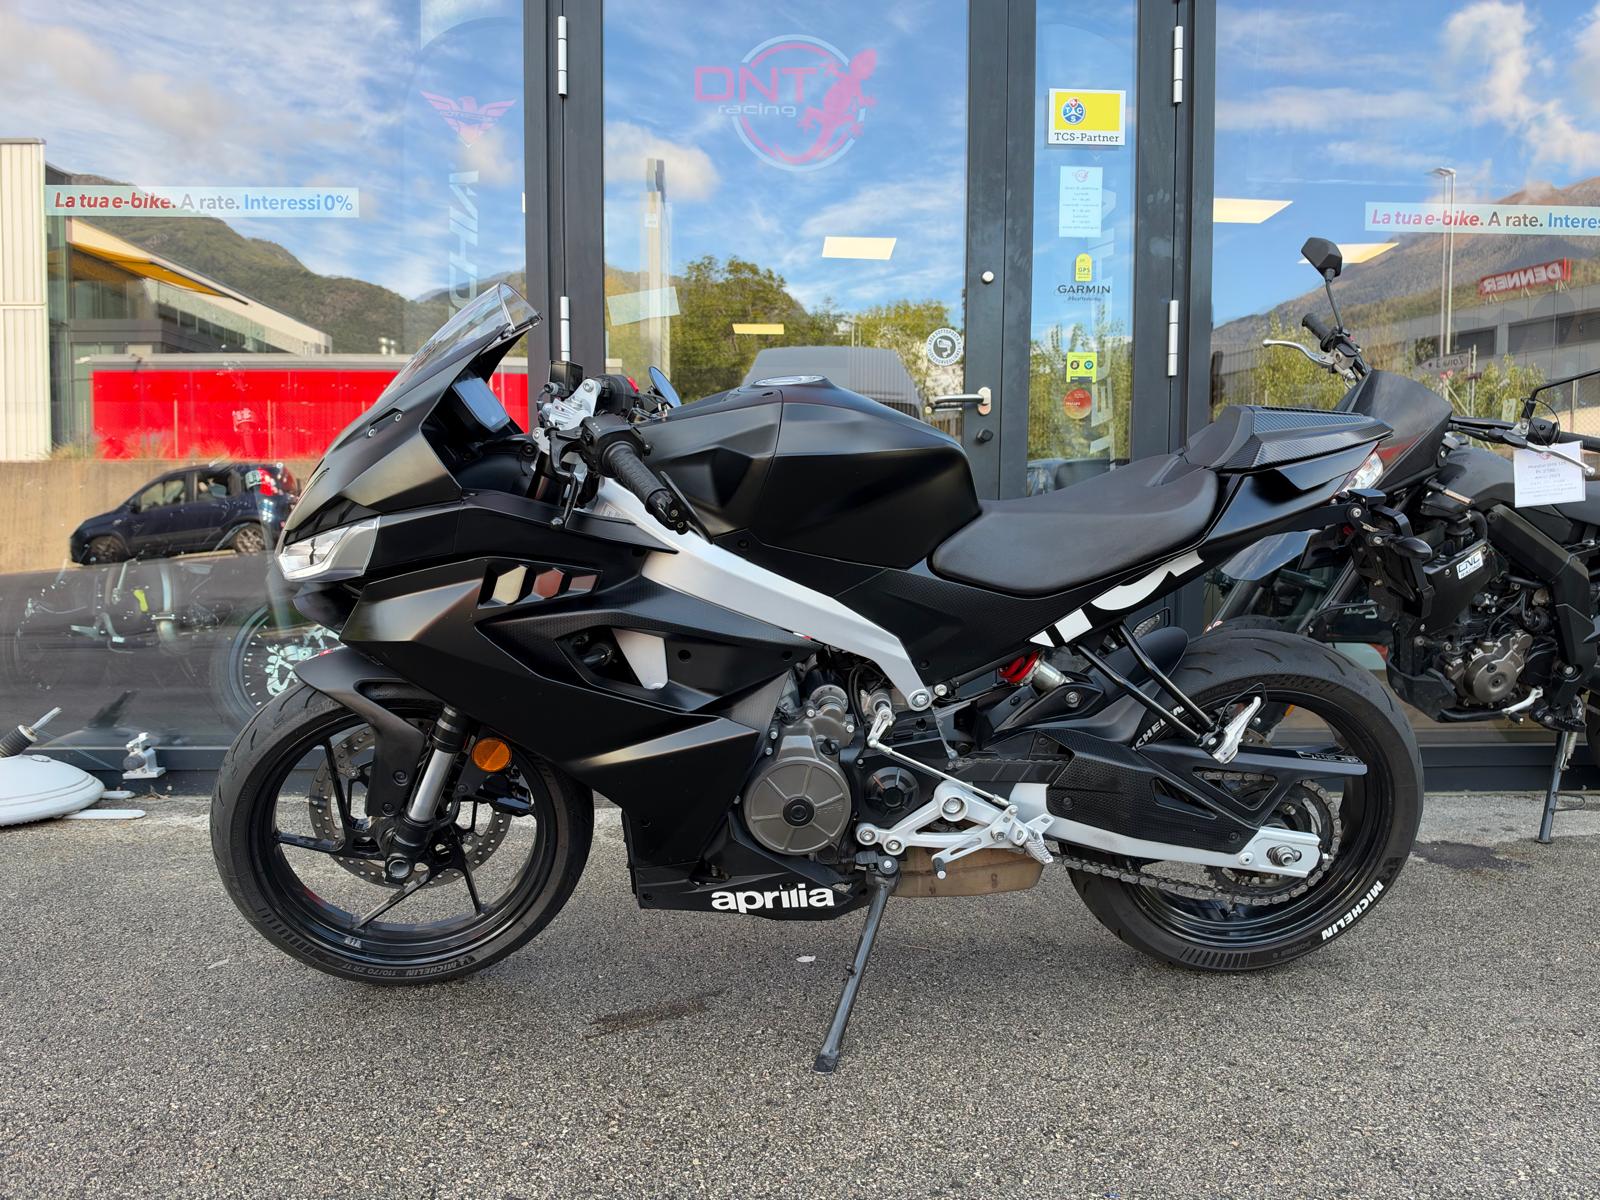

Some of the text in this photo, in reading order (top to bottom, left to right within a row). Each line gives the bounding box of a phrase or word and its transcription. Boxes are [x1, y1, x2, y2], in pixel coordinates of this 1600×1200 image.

[695, 66, 818, 102] DNT
[718, 102, 797, 117] racing
[1055, 132, 1120, 142] TCS-Partner
[55, 192, 353, 211] La tua e-bike. A rate. Interessi 0%
[1371, 209, 1391, 225] La
[1394, 211, 1422, 225] tua
[1424, 210, 1484, 226] e-bike.
[1488, 211, 1501, 227] A
[1505, 213, 1543, 228] rate.
[1057, 284, 1111, 294] GARMIN
[711, 883, 835, 914] aprilia
[1321, 880, 1384, 940] MICHELIN
[406, 962, 456, 977] MICHELIN
